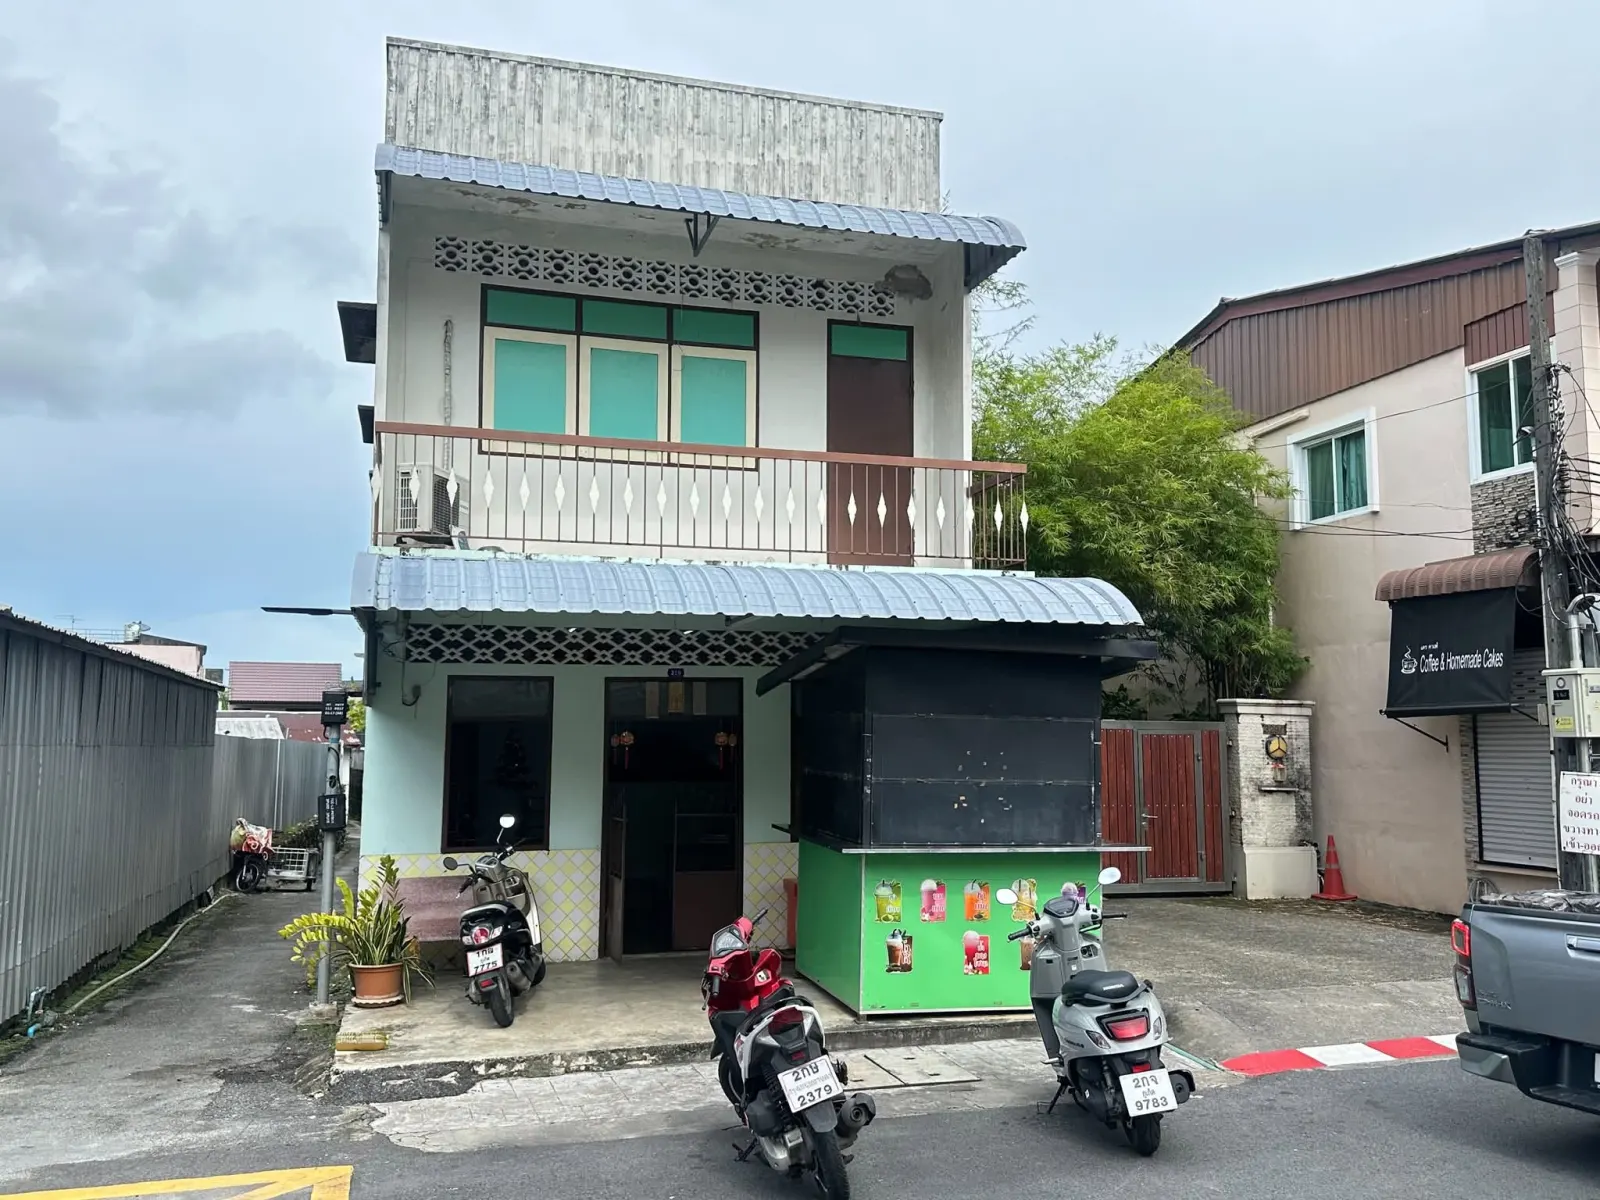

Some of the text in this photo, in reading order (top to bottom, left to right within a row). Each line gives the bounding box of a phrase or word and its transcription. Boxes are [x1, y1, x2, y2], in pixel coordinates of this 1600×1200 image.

[1420, 648, 1504, 673] Coffee & Homemade Cakes
[1571, 777, 1597, 790] กรุณา
[1575, 792, 1593, 805] อย่า
[1563, 825, 1600, 836] ขวางทา
[474, 960, 498, 975] 7775
[1132, 1075, 1159, 1089] 2กจ
[797, 1084, 833, 1107] 2379
[1135, 1096, 1168, 1111] 9783
